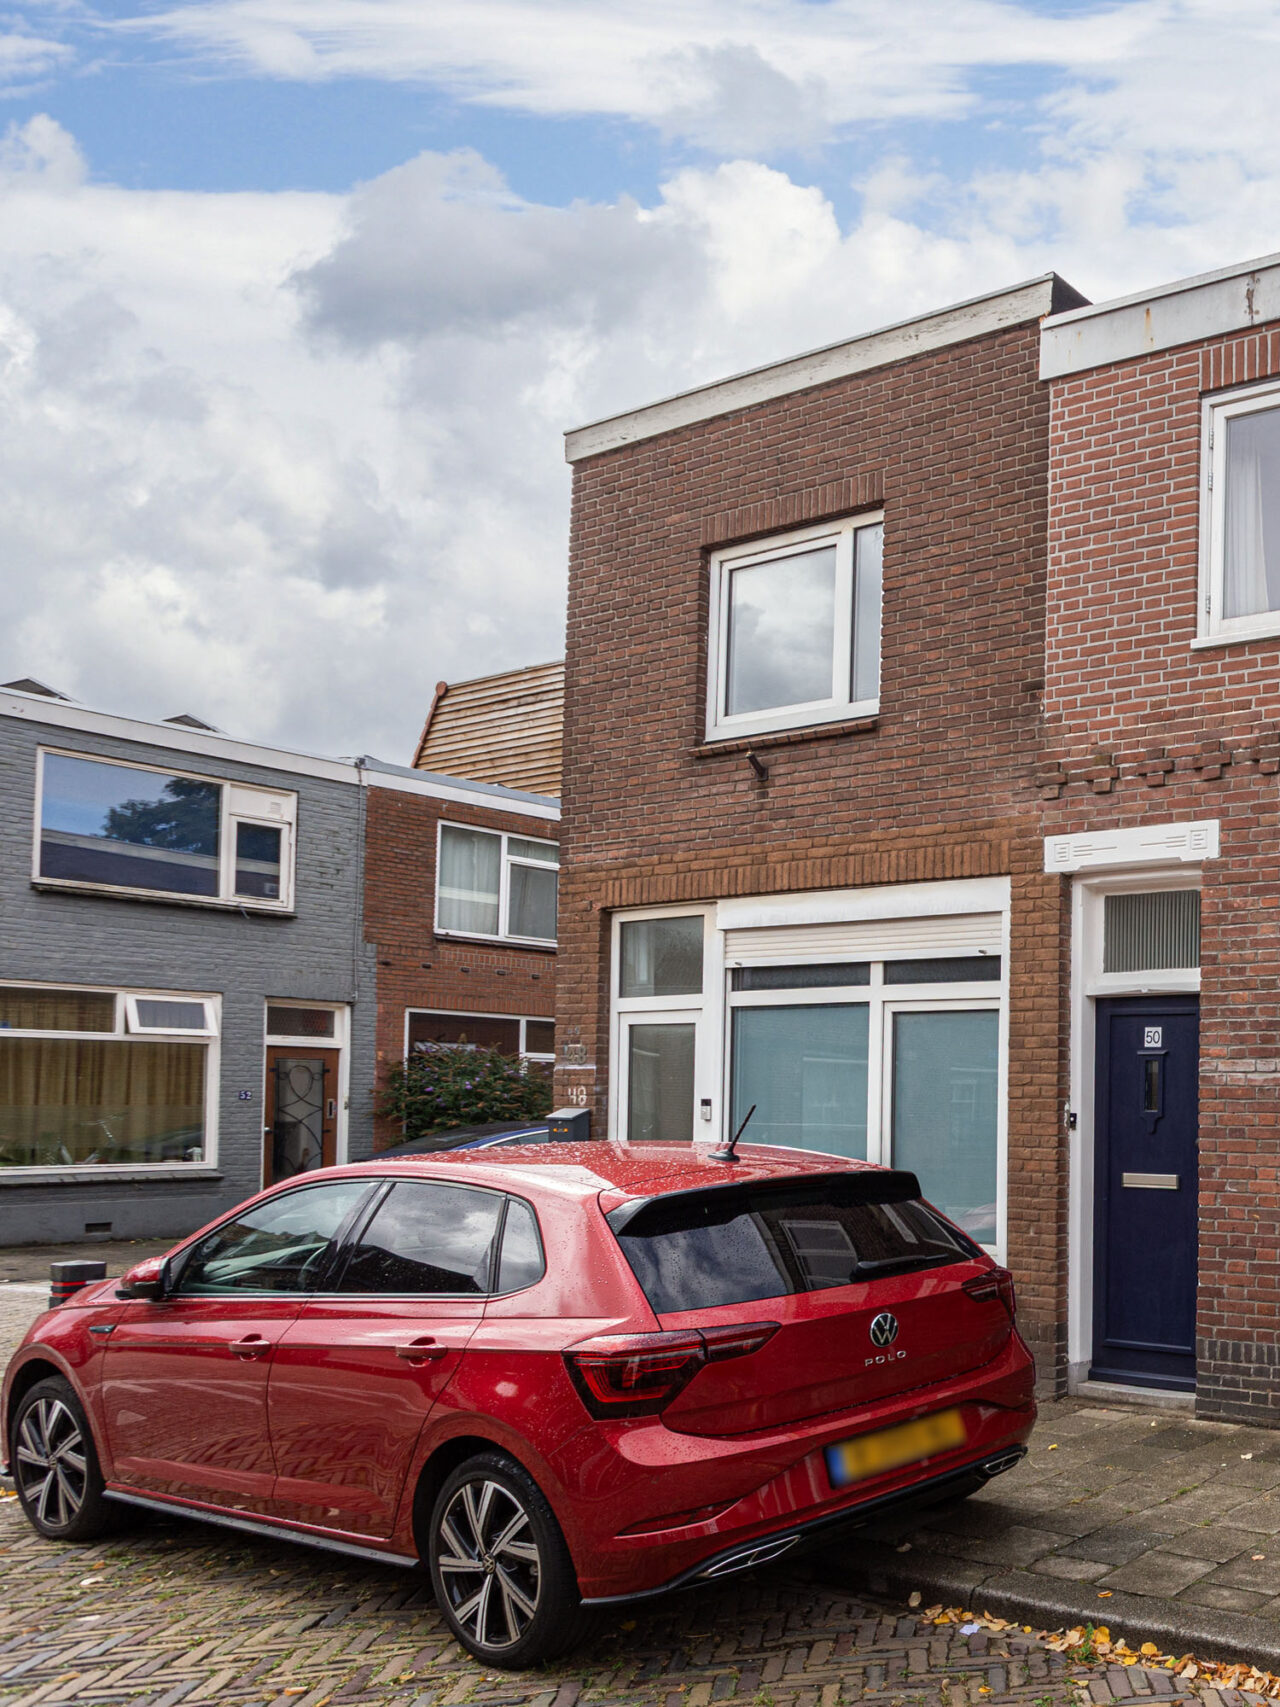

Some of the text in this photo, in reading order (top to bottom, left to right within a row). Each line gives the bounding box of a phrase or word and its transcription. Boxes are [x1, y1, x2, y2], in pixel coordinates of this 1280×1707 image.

[1146, 1030, 1161, 1044] 50
[239, 1090, 252, 1100] 52
[567, 1085, 587, 1106] 48
[864, 1350, 906, 1367] POLO
